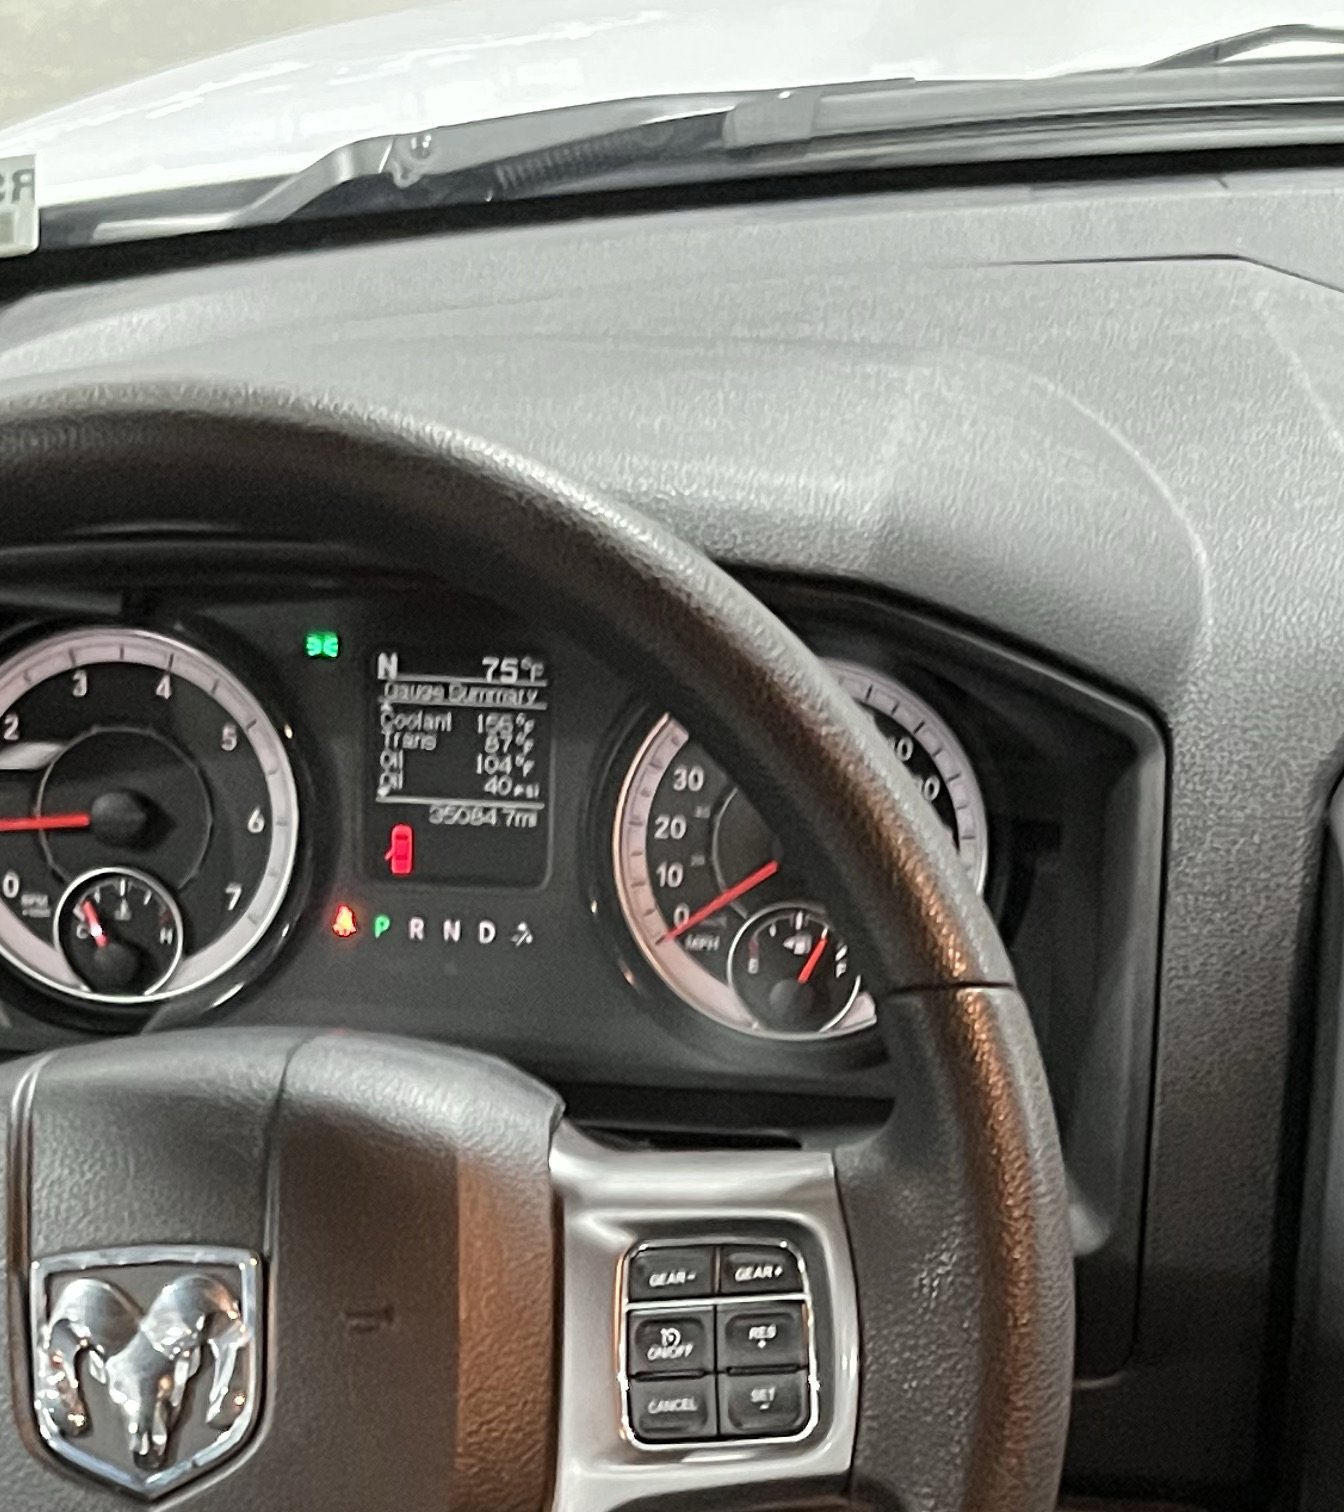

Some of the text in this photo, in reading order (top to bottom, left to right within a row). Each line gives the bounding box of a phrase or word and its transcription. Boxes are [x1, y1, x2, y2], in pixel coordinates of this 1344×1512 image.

[377, 652, 544, 684] N 75°F
[72, 671, 87, 696] 3
[155, 674, 172, 700] 4
[4, 715, 19, 740] 2
[221, 724, 237, 751] 5
[672, 766, 704, 792] 30
[247, 807, 265, 834] 6
[654, 814, 687, 840] 20
[2, 872, 20, 898] 0
[655, 862, 684, 888] 10
[224, 883, 242, 911] 7
[673, 903, 690, 928] 0
[159, 927, 174, 945] H
[373, 915, 496, 944] P R N D
